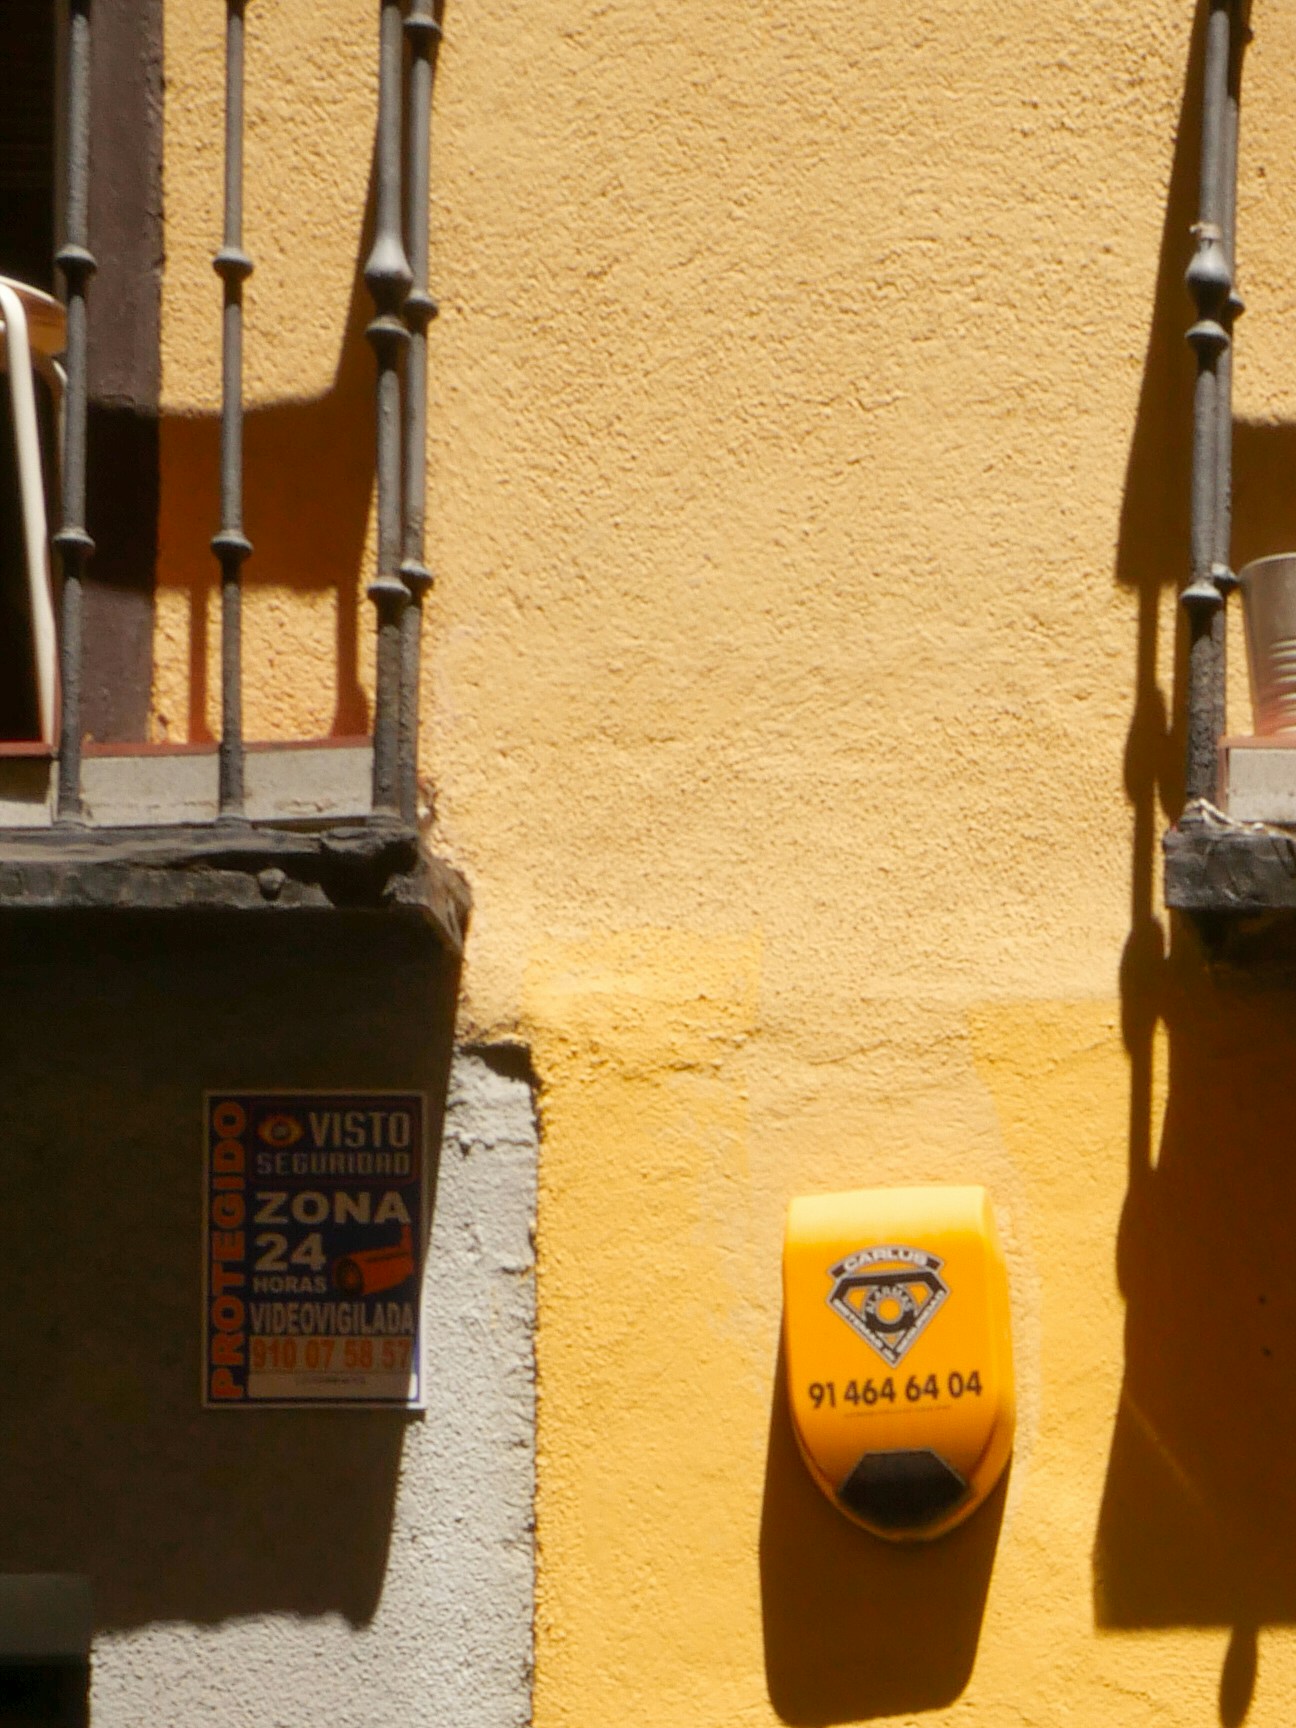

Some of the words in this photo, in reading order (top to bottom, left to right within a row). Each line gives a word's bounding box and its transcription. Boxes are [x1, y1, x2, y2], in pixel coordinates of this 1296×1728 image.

[308, 1111, 411, 1148] VISTO
[256, 1151, 411, 1175] SEGURIDAD
[253, 1190, 412, 1225] ZONA
[212, 1102, 246, 1398] PROTEGIDO
[253, 1231, 327, 1272] 24
[252, 1276, 328, 1294] HORAS
[250, 1301, 415, 1335] VIDEOVIGILADA
[252, 1338, 297, 1370] 910
[305, 1338, 336, 1370] 07
[344, 1338, 374, 1370] 58
[381, 1338, 412, 1370] 57
[808, 1382, 836, 1409] 91
[844, 1376, 897, 1406] 464
[905, 1373, 939, 1402] 64
[948, 1370, 982, 1398] 04
